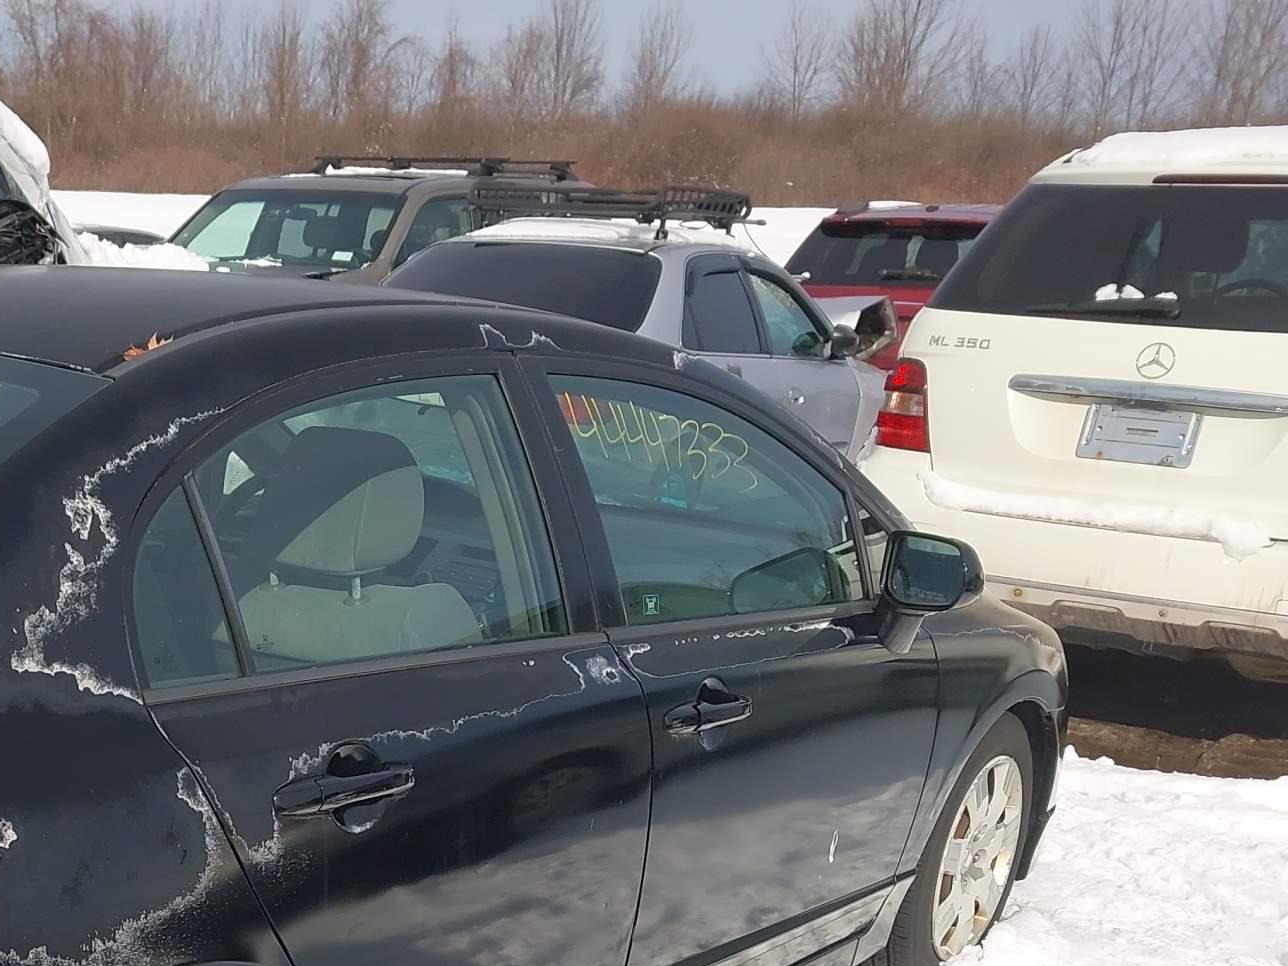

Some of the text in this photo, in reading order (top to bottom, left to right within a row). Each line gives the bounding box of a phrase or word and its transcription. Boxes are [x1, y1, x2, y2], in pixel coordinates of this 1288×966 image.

[928, 335, 991, 350] ML 350
[564, 391, 758, 494] 44447333
